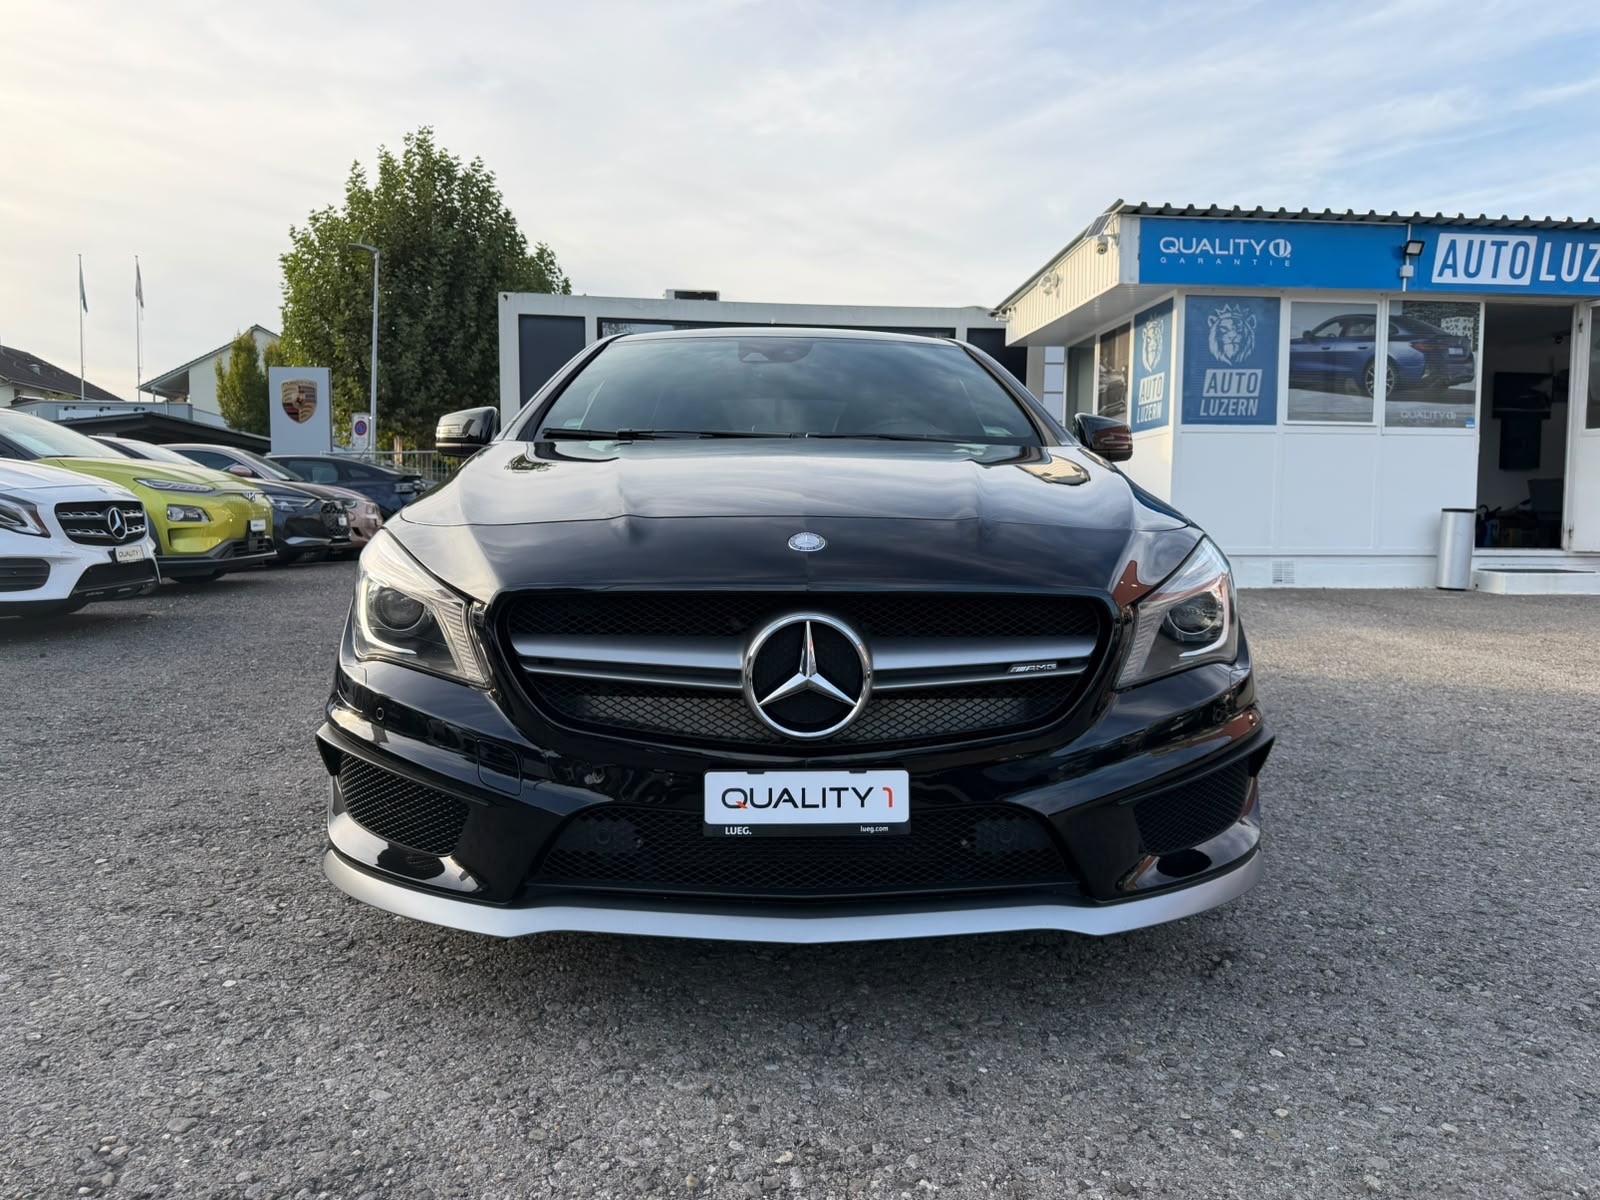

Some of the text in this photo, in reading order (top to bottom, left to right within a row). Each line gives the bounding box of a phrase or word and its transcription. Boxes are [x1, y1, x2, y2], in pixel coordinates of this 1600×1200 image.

[1159, 236, 1266, 256] QUALITY
[1160, 257, 1290, 267] GARANTIE
[1437, 239, 1530, 280] AUTO
[1140, 375, 1163, 402] AUTO
[1205, 372, 1259, 395] AUTO
[1136, 402, 1162, 423] LUZERN
[1200, 399, 1258, 416] LUZERN
[721, 787, 894, 809] QUALITY 1
[725, 825, 889, 835] LUEG. lueg.com
